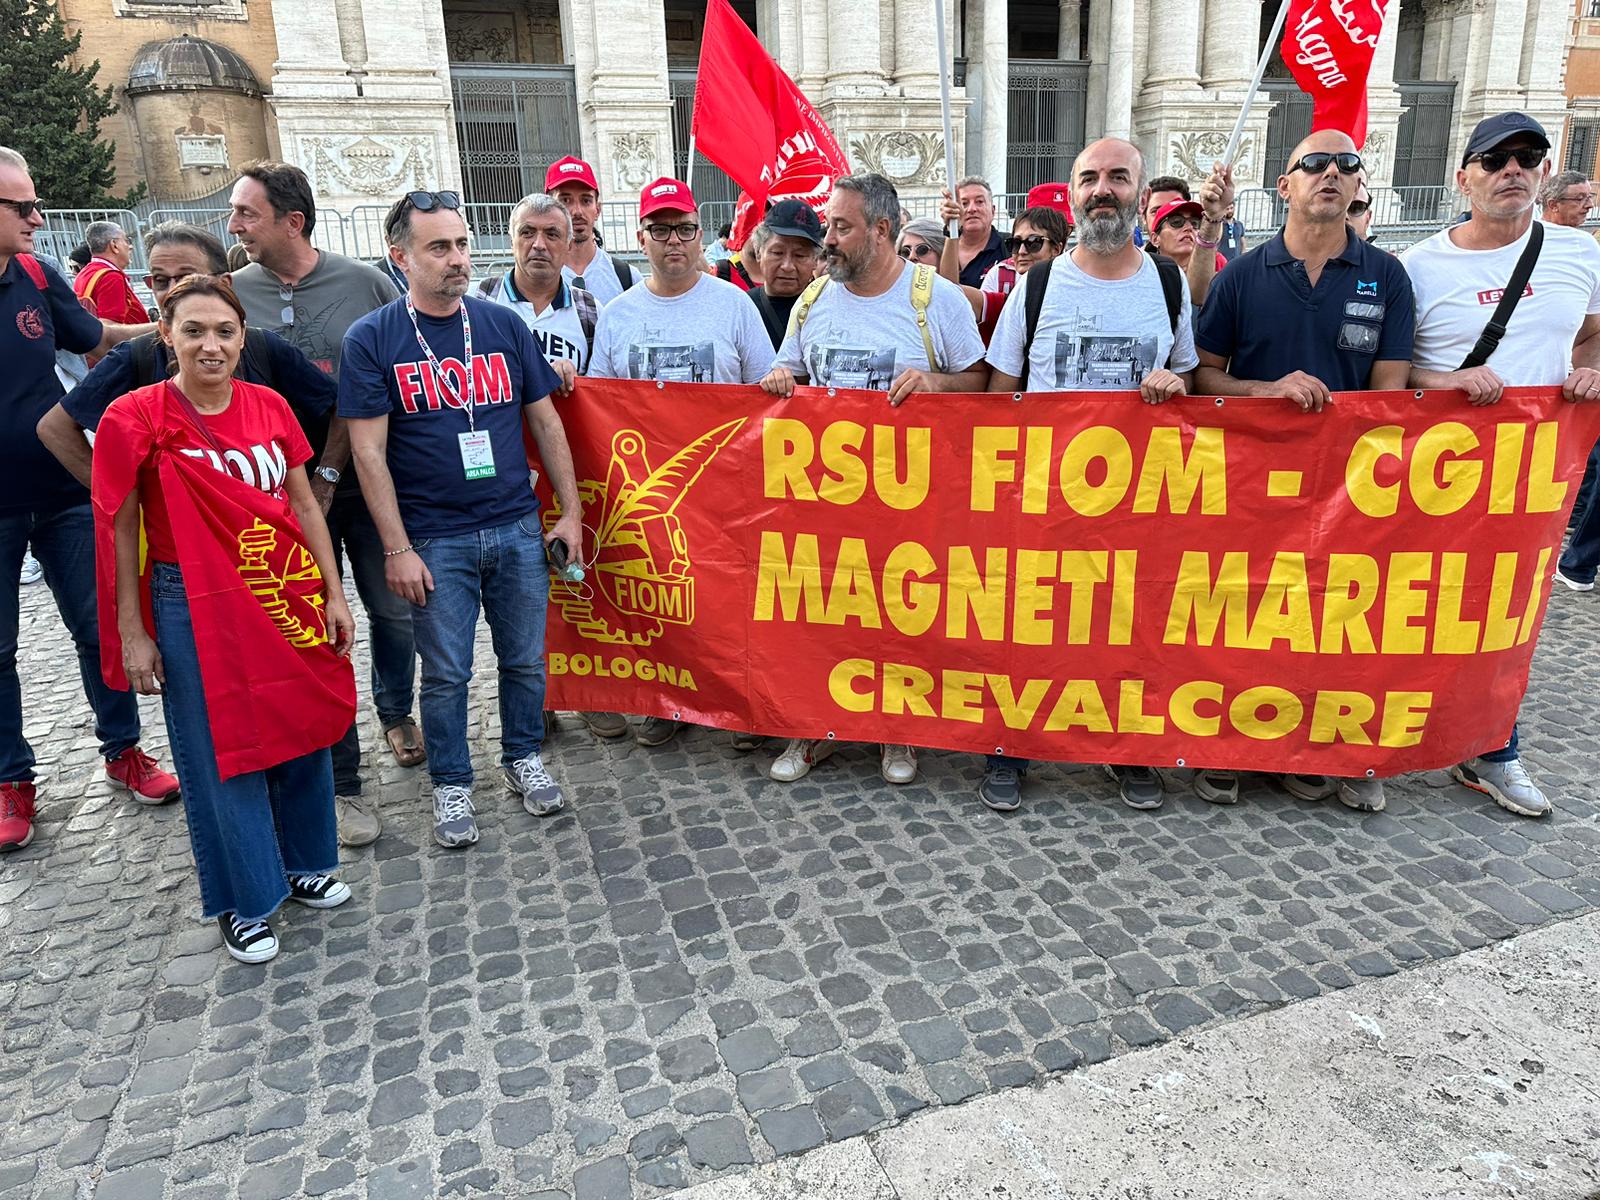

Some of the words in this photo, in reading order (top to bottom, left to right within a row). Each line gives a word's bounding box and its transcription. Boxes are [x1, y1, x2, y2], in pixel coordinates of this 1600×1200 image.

[393, 352, 513, 414] FIOM
[180, 440, 287, 491] IOM
[466, 469, 480, 478] AREA
[480, 467, 495, 475] PALCO
[763, 418, 931, 511] RSU
[971, 425, 1227, 518] FIOM
[1267, 471, 1302, 497] -
[1346, 422, 1569, 518] CGIL
[615, 576, 683, 618] FIOM
[753, 530, 1138, 646] MAGNETI
[1163, 548, 1552, 656] MARELLI
[548, 652, 698, 691] BOLOGNA
[828, 658, 1433, 748] CREVALCORE
